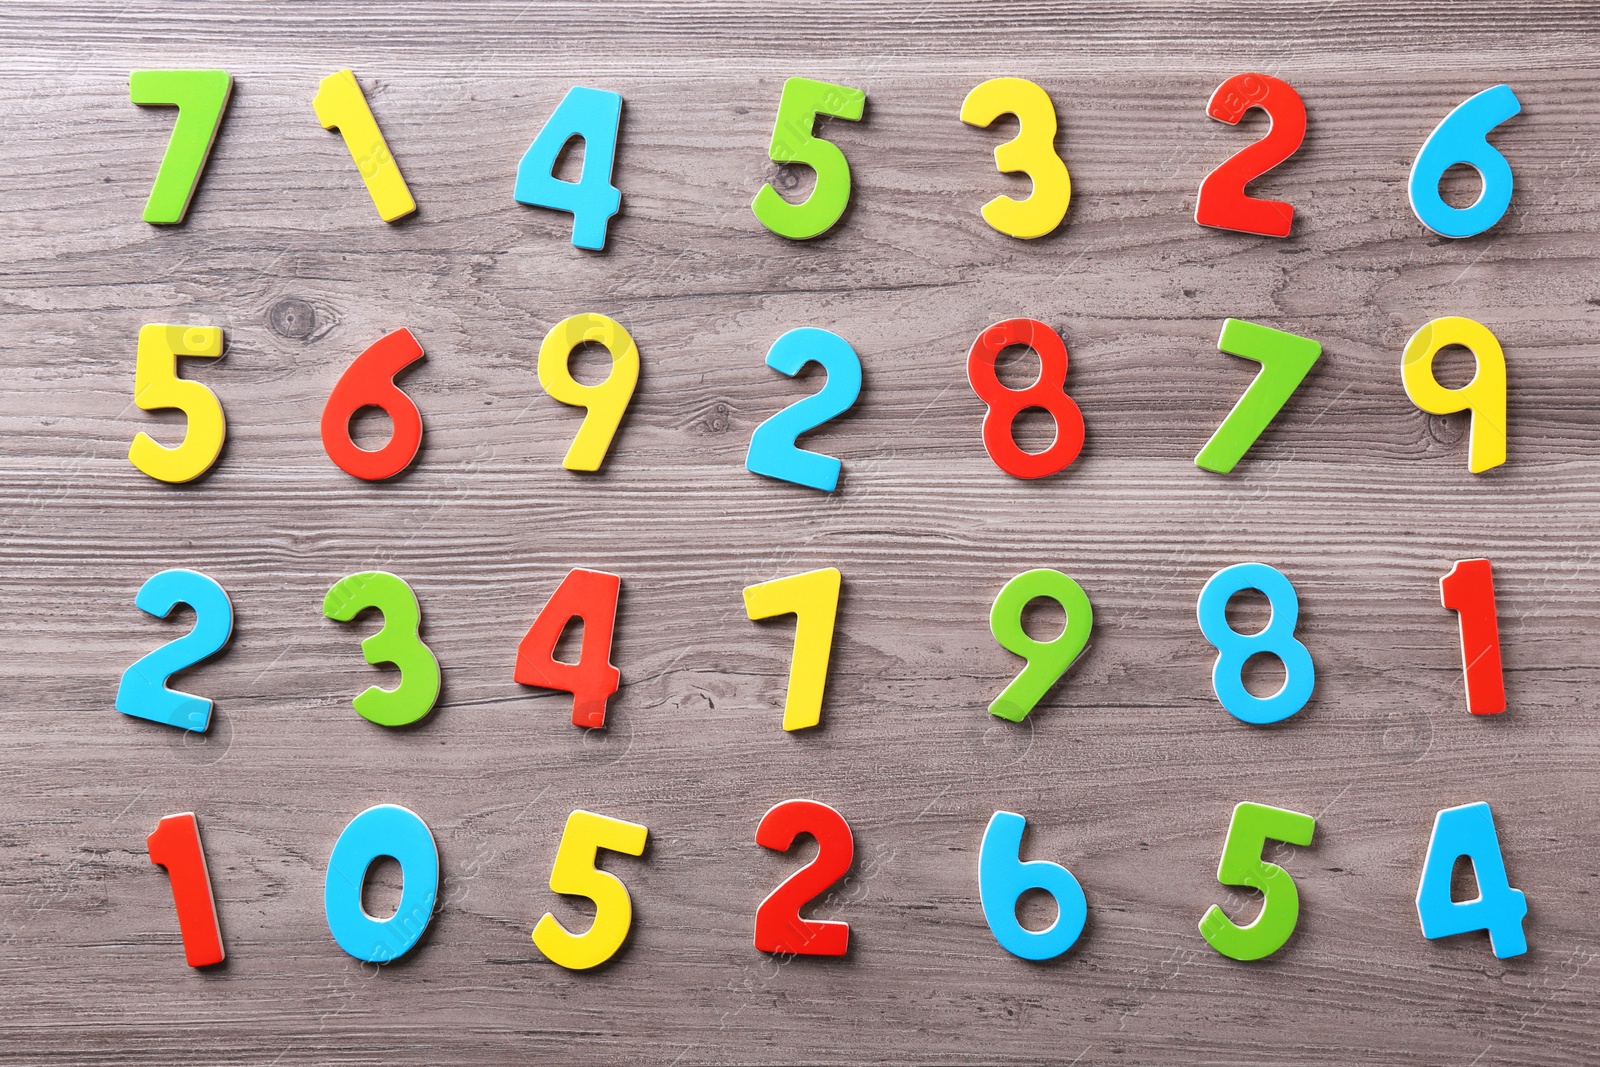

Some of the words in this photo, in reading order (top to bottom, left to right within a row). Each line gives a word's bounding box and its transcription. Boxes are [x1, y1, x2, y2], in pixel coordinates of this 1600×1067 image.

[128, 69, 234, 225] 7
[313, 69, 417, 223] 1
[513, 86, 623, 250] 4
[751, 77, 866, 240] 5
[960, 77, 1072, 240] 3
[1195, 73, 1308, 238] 2
[1409, 84, 1522, 239] 6
[127, 323, 225, 484] 5
[320, 327, 425, 481] 6
[537, 313, 641, 473] 9
[745, 327, 863, 493] 2
[966, 318, 1086, 480] 8
[1195, 318, 1323, 474] 7
[1402, 316, 1508, 475] 9
[115, 569, 235, 733] 2
[322, 571, 441, 728] 3
[513, 567, 622, 730] 4
[743, 568, 842, 733] 7
[987, 568, 1094, 723] 9
[1198, 563, 1317, 725] 8
[1440, 559, 1508, 716] 1
[147, 812, 226, 969] 1
[324, 804, 440, 964] 0
[531, 810, 649, 971] 5
[754, 800, 855, 957] 2
[978, 812, 1088, 962] 6
[1199, 802, 1317, 962] 5
[1416, 802, 1529, 960] 4
